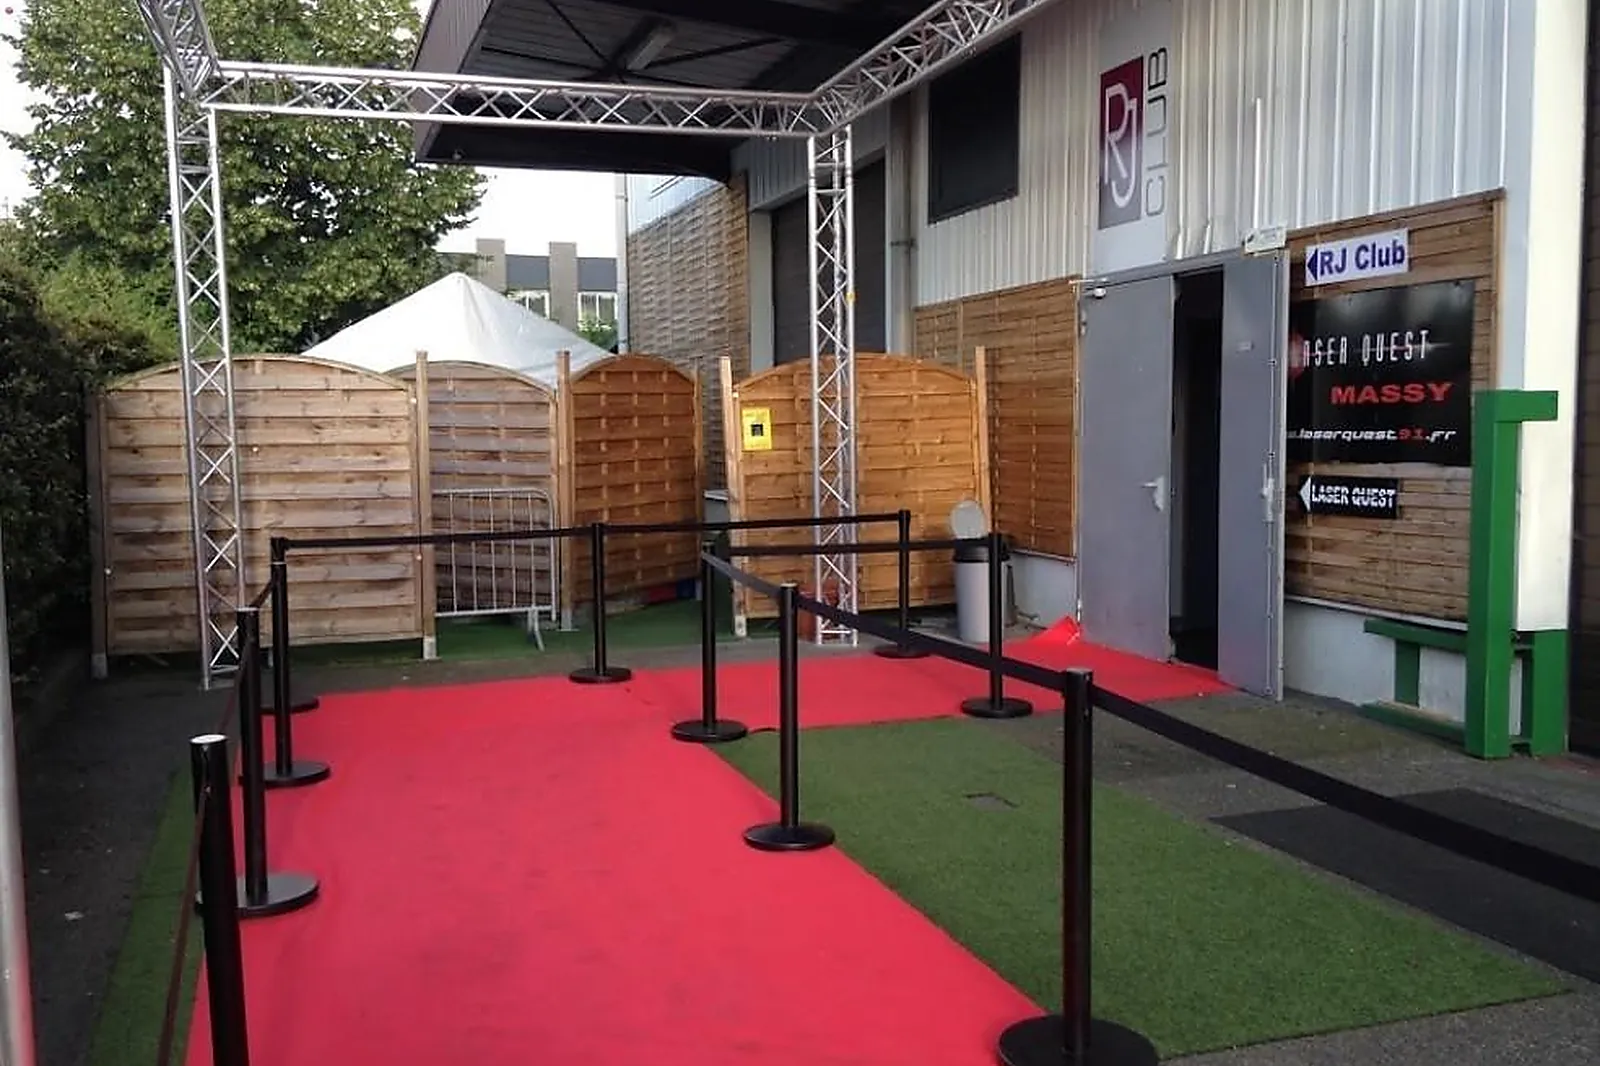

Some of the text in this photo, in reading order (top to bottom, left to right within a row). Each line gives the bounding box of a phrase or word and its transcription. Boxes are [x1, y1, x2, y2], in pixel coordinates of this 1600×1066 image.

[1104, 83, 1138, 208] RJ
[1145, 47, 1168, 216] CLUB
[1319, 238, 1405, 276] RJ Club
[1293, 329, 1429, 369] ASER QUEST
[1330, 382, 1453, 405] MASSY
[1311, 484, 1396, 508] LASER QUEST
